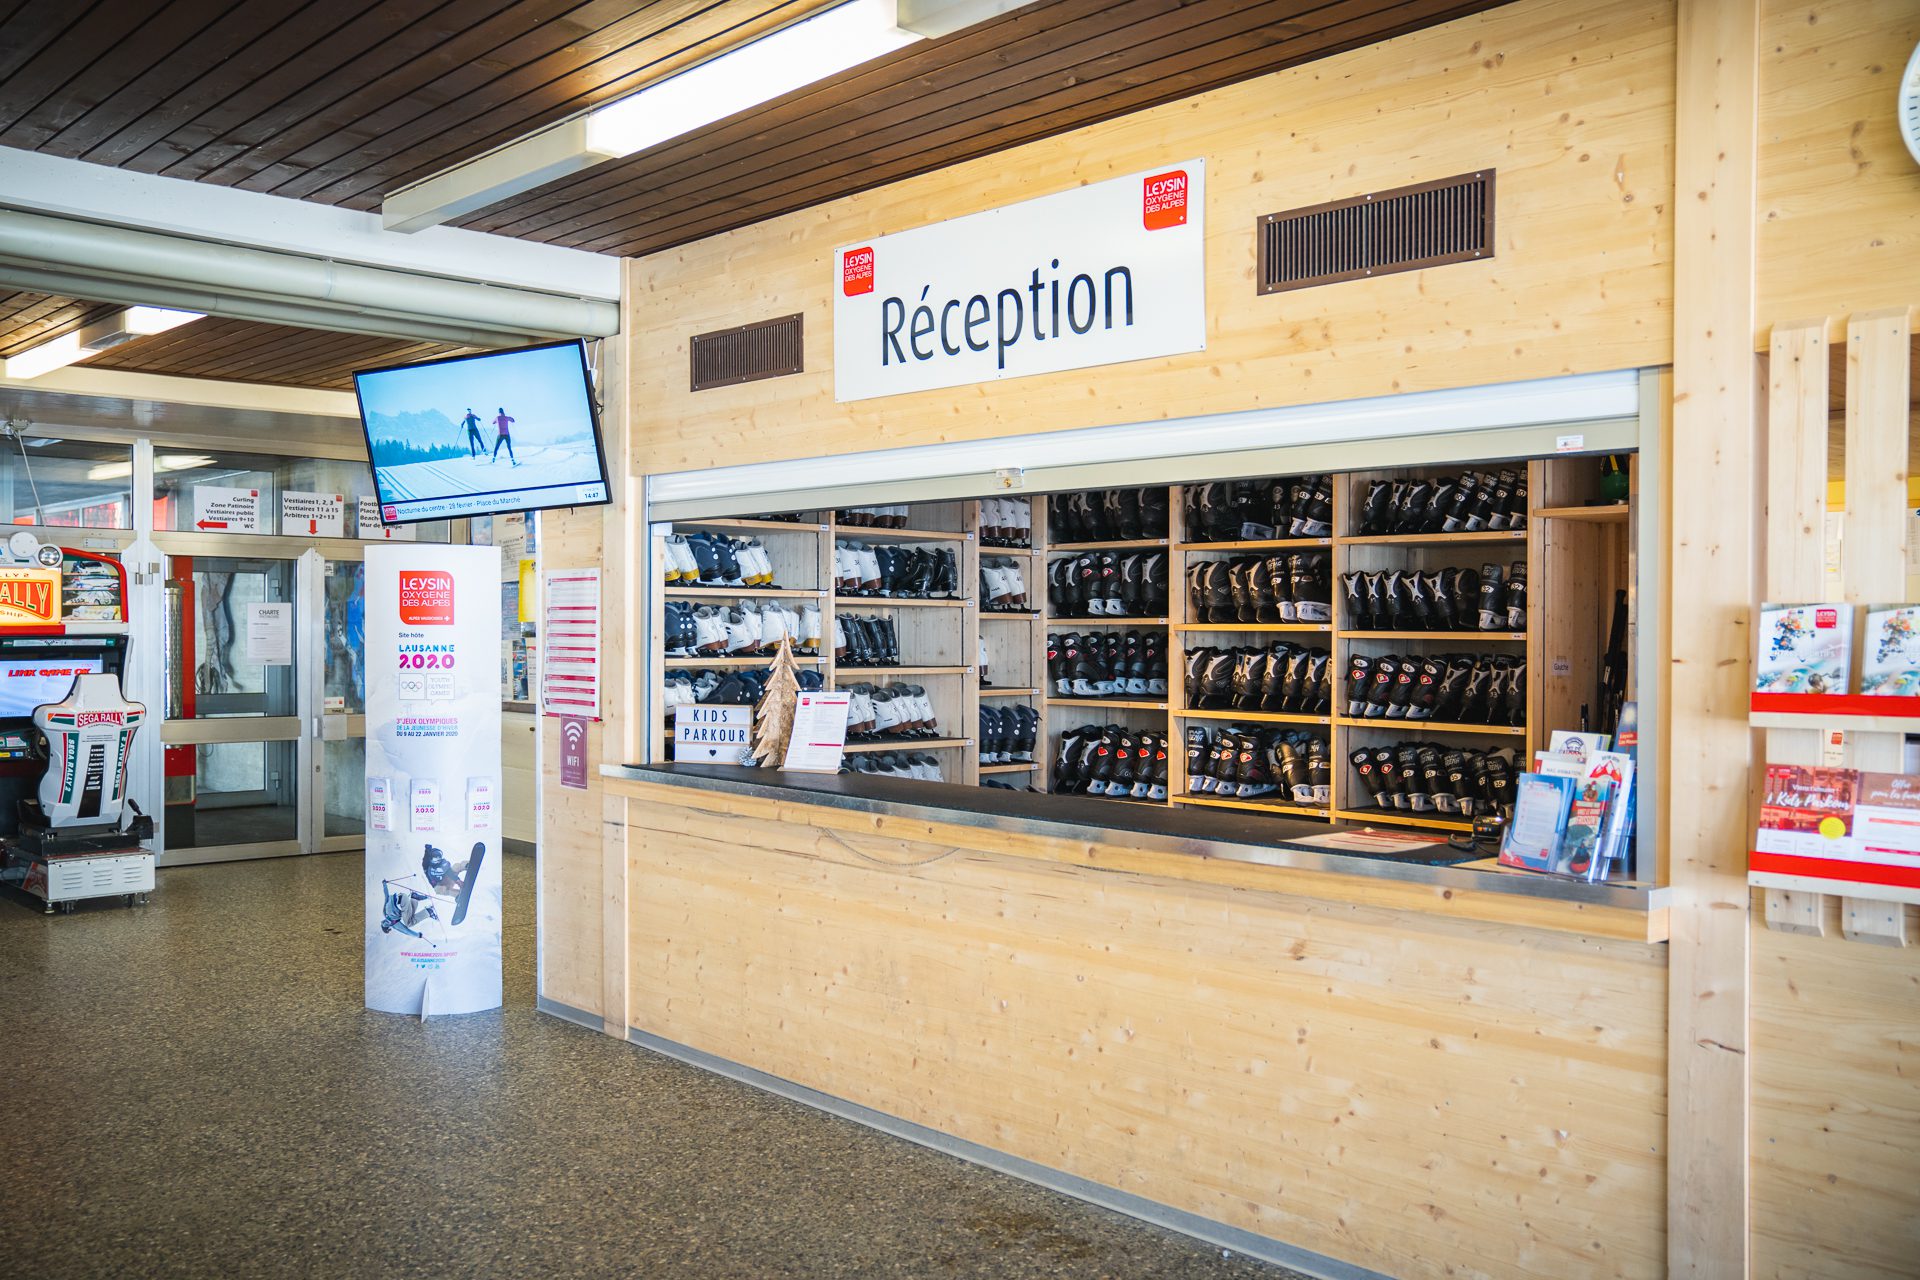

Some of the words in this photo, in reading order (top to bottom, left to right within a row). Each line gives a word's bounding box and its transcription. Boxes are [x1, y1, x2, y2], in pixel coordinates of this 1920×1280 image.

[1146, 176, 1186, 197] LEYSIN
[1146, 190, 1184, 205] OXYGENE
[1146, 204, 1160, 214] DES
[1161, 198, 1184, 210] ALPES
[845, 252, 872, 268] LEYSIN
[845, 263, 872, 275] OXYGENE
[845, 274, 855, 282] DES
[856, 271, 872, 280] ALPES
[882, 258, 1134, 369] Réception
[402, 578, 450, 590] LEYSIN
[0, 582, 49, 614] ALLY
[402, 591, 450, 599] OXYGENE
[8, 669, 37, 677] LINK
[39, 668, 72, 676] GAME
[1554, 663, 1569, 671] Gauche
[78, 714, 99, 726] SEGA
[100, 712, 124, 726] RALLY
[693, 709, 728, 722] KIDS
[684, 728, 745, 742] PARKOUR
[567, 755, 580, 767] WIFI
[1776, 792, 1802, 807] Kids
